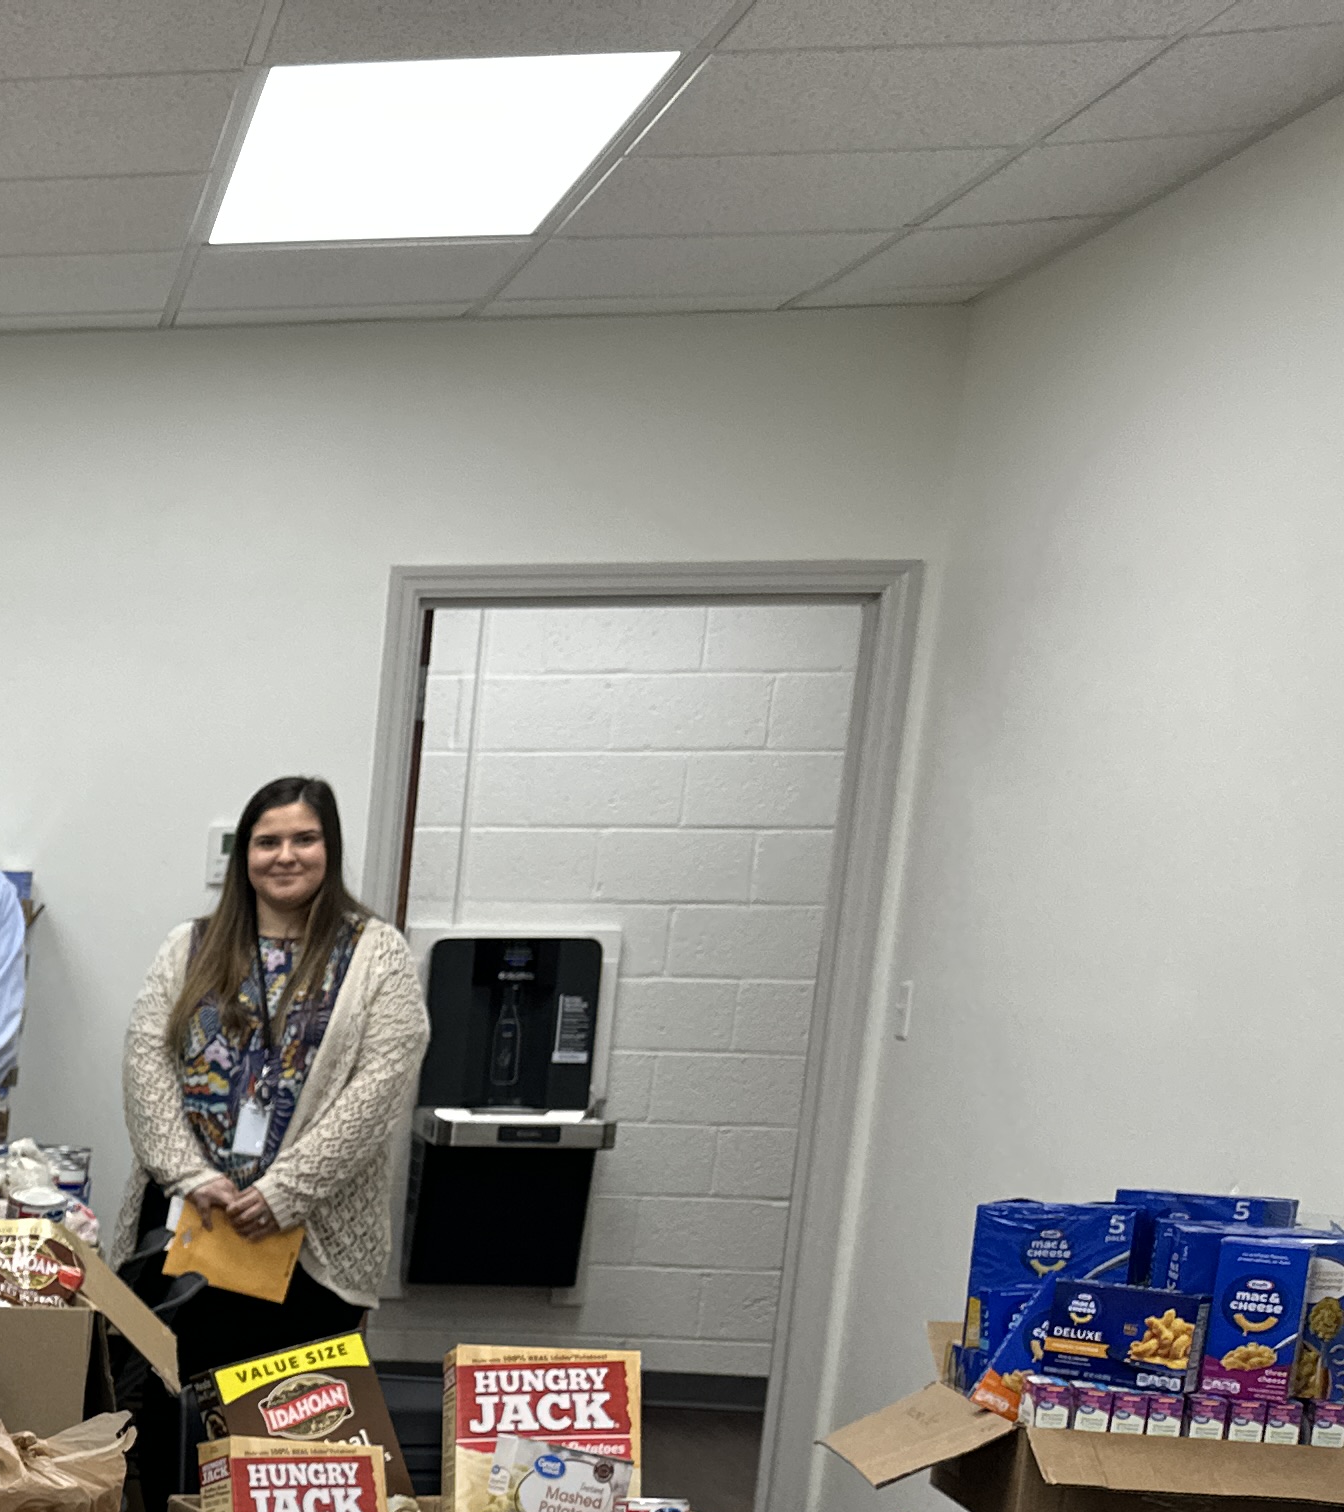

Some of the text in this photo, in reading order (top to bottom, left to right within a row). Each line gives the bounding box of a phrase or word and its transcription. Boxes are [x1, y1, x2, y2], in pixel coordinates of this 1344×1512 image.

[1233, 1202, 1250, 1220] 5
[1109, 1215, 1125, 1234] 5
[1105, 1234, 1126, 1243] pack
[1236, 1292, 1280, 1304] mac &
[1053, 1327, 1102, 1342] DELUXE
[236, 1343, 348, 1383] VALUE SIZE
[474, 1368, 608, 1394] HUNGRY
[267, 1386, 345, 1429] IDAHOAN
[469, 1392, 615, 1433] JACK
[202, 1464, 229, 1485] JACK
[247, 1462, 359, 1487] HUNGRY
[545, 1485, 603, 1509] Mashed
